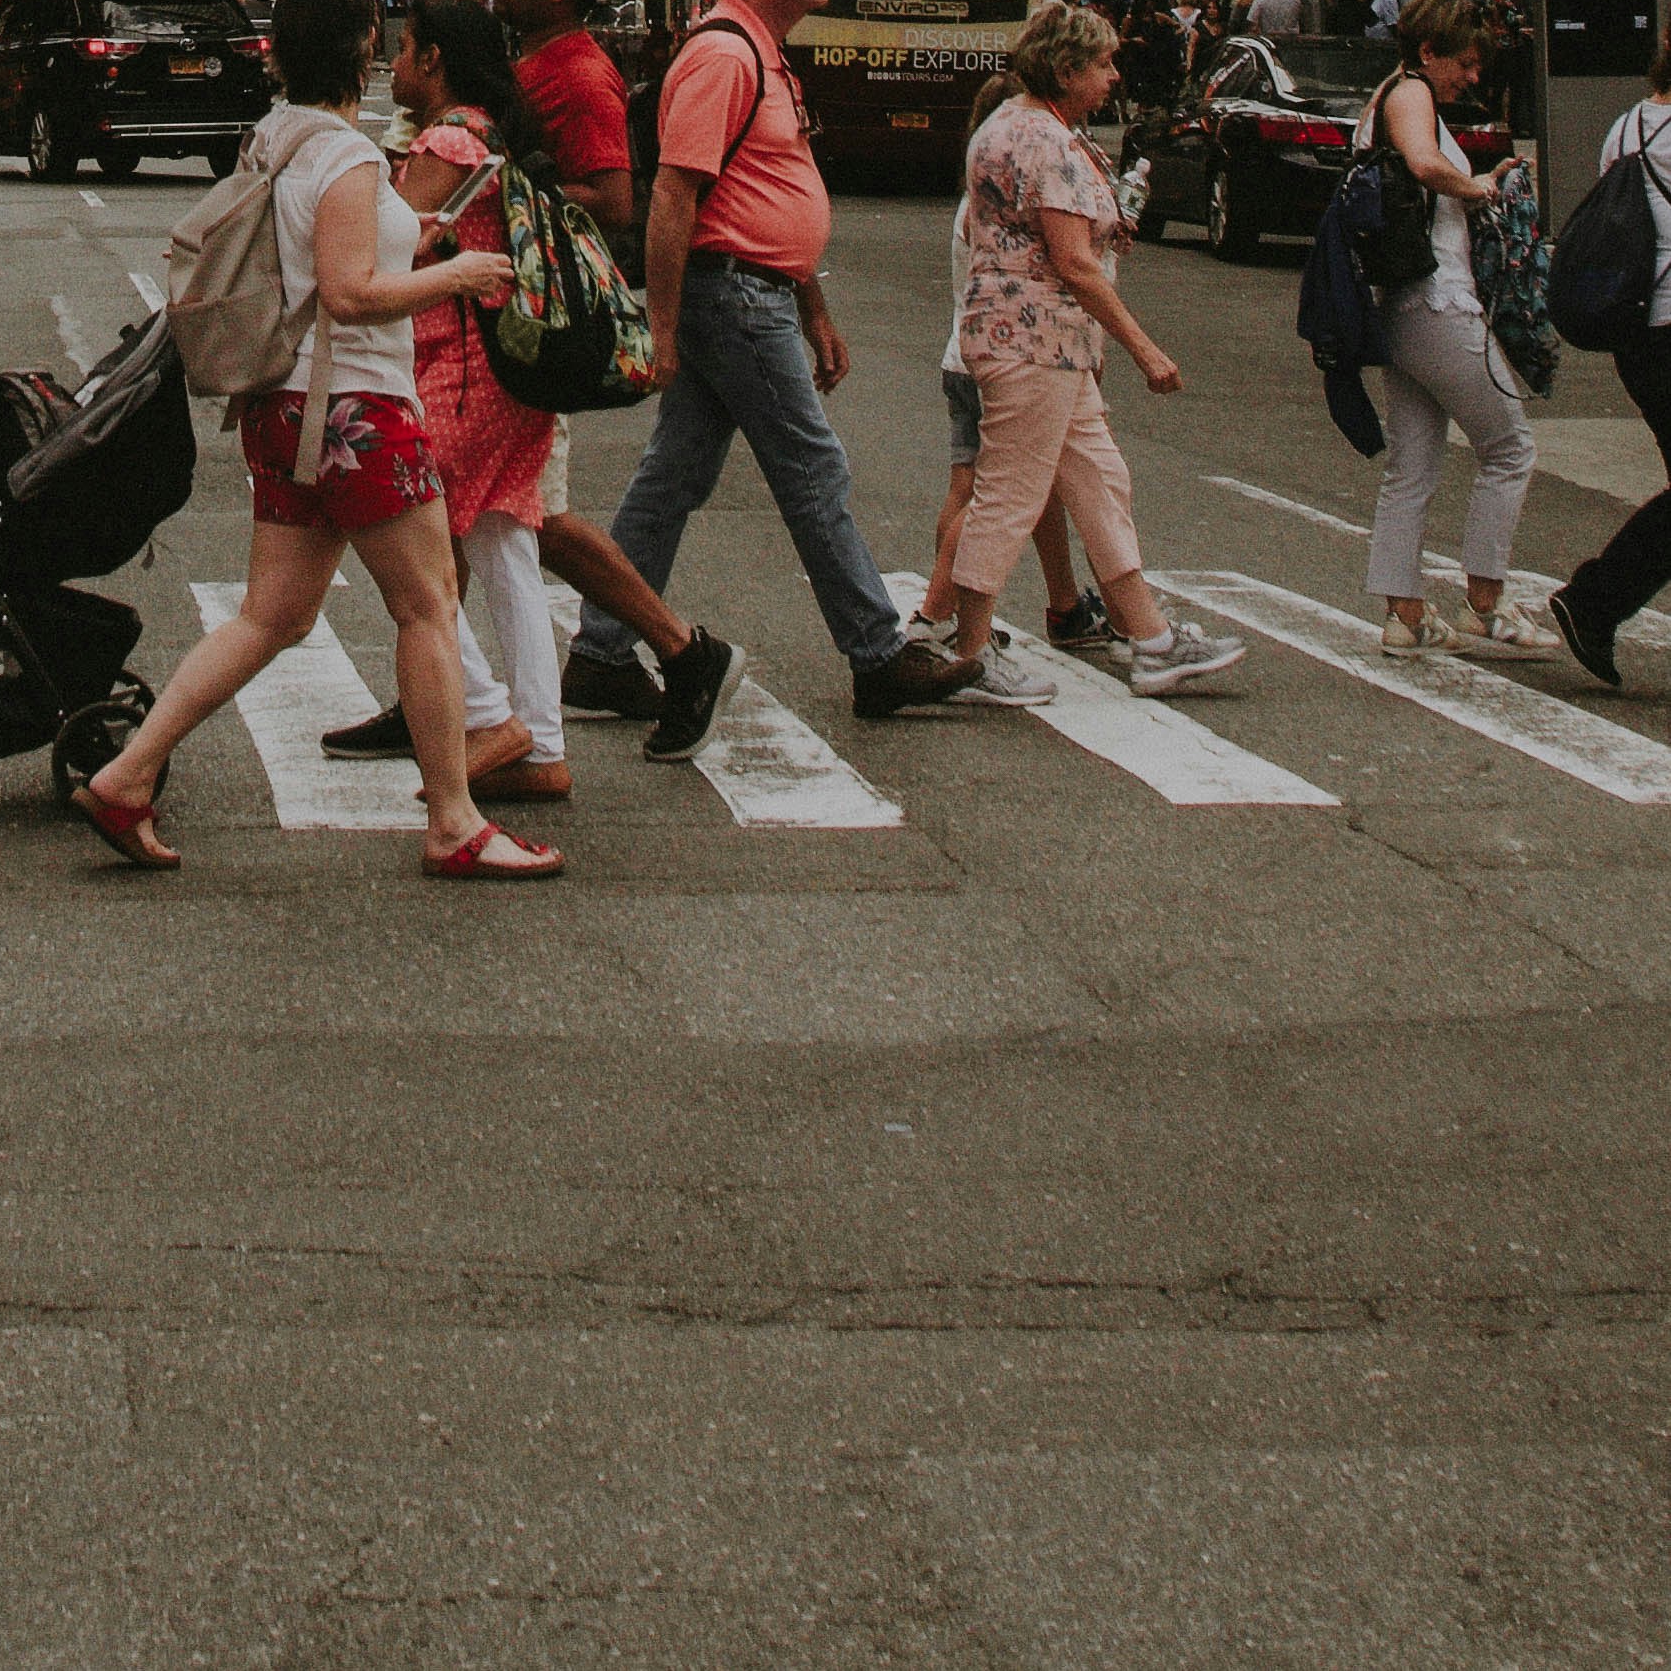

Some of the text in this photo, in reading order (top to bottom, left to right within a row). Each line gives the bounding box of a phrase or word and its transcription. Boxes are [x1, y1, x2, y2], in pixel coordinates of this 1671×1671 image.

[905, 28, 1008, 51] DISCOVER
[814, 47, 1008, 72] HOP-OFF EXPLORE
[867, 71, 955, 83] BIGBUSTOURS.COM
